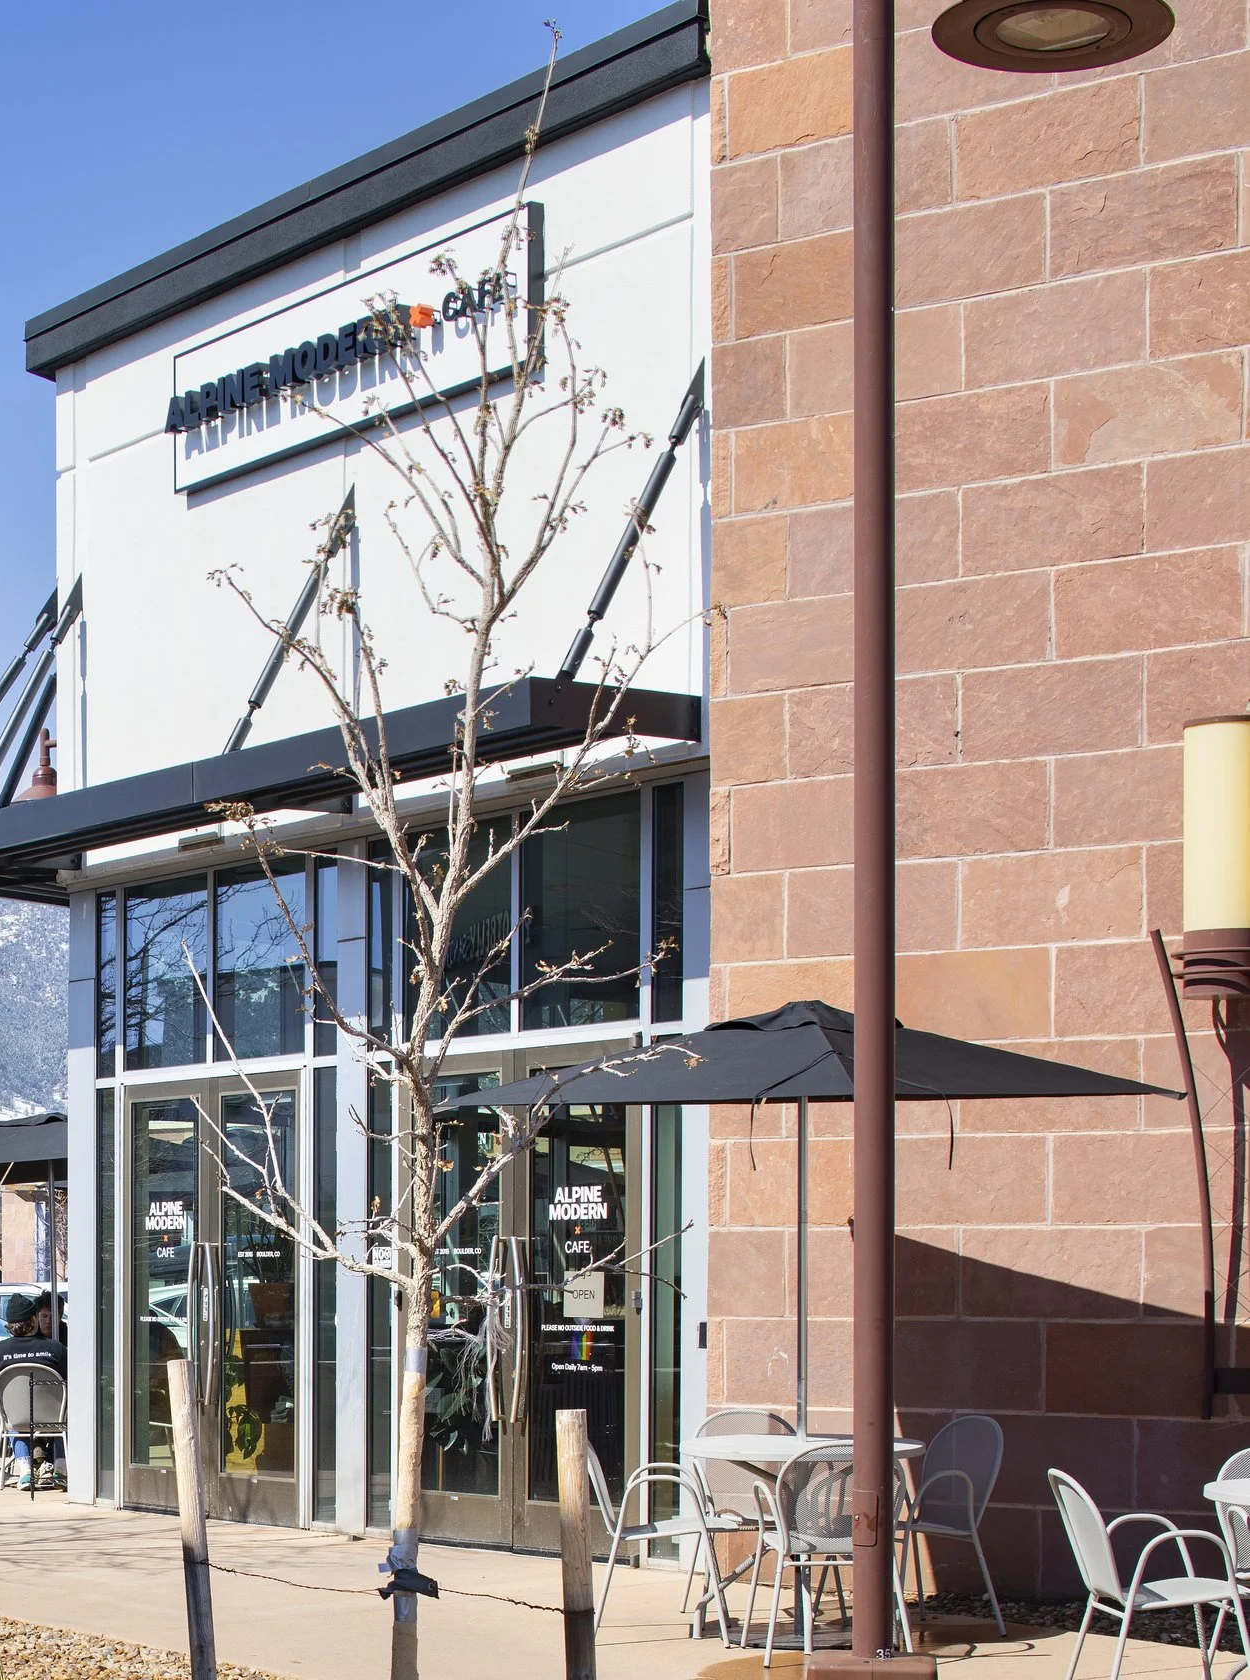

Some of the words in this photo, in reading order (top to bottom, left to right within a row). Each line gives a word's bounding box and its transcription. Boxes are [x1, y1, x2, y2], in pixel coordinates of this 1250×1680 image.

[164, 362, 270, 434] ALPINE
[554, 1186, 602, 1203] ALPINE
[150, 1201, 183, 1216] ALPINE
[549, 1202, 608, 1220] MODERN
[145, 1215, 186, 1230] MODERN
[156, 1247, 175, 1258] CAFE
[565, 1241, 590, 1254] CAFE
[572, 1289, 595, 1300] OPEN
[552, 1362, 564, 1371] Open
[565, 1363, 577, 1371] Daily
[591, 1364, 603, 1372] 5pm
